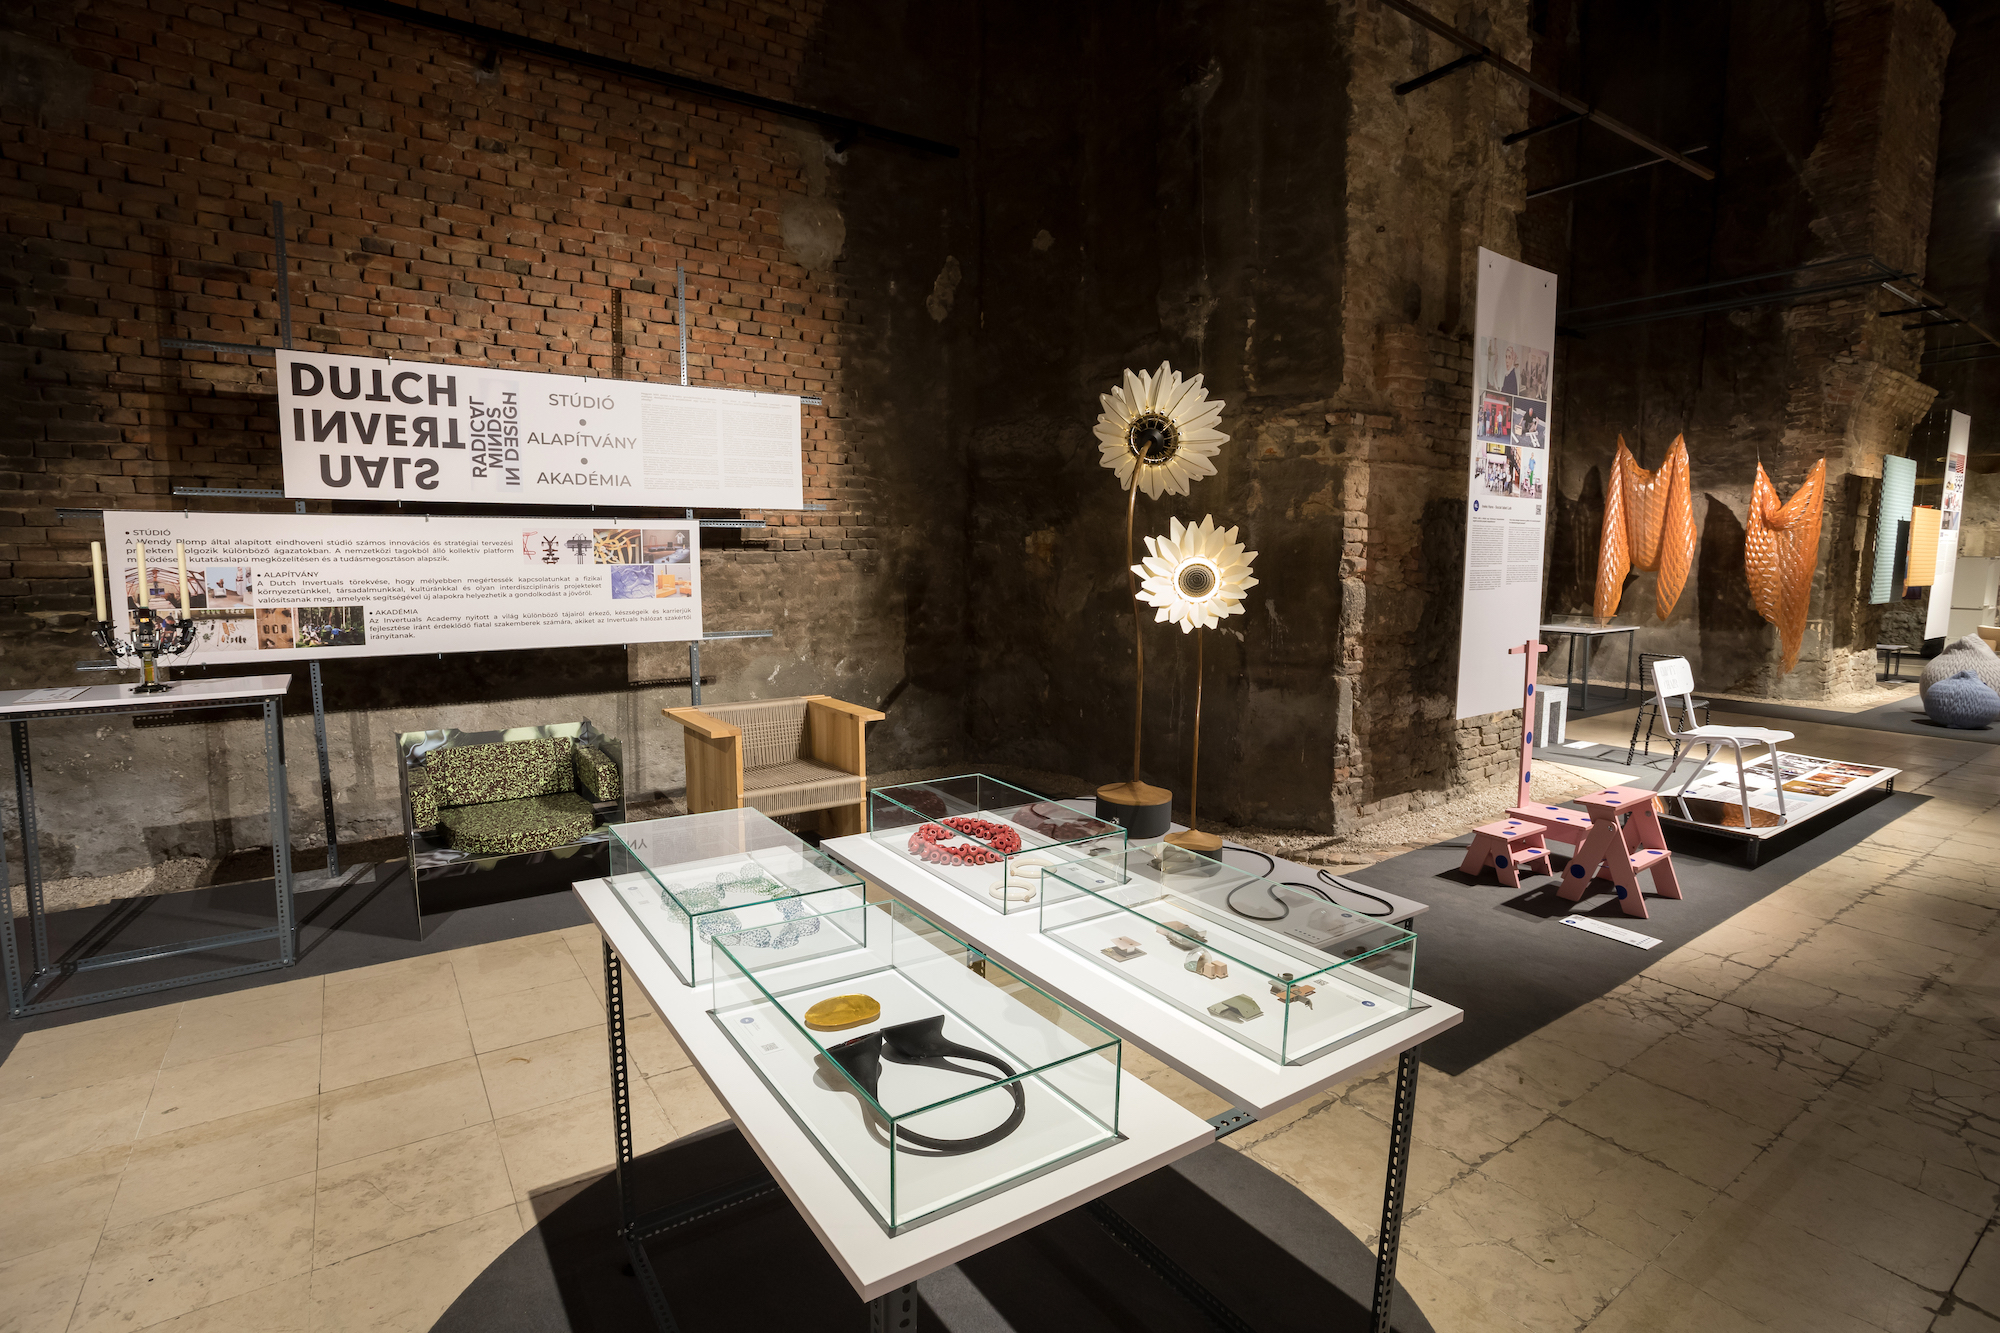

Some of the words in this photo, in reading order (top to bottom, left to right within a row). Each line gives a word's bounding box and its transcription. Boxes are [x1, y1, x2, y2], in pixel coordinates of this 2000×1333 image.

[290, 362, 456, 408] DUTCH
[549, 393, 615, 410] STÚDIÓ
[293, 408, 466, 450] INVERT
[469, 396, 488, 478] RADICAL
[487, 408, 504, 468] MINDS
[527, 431, 638, 450] ALAPÍTVÁNY
[537, 471, 632, 488] AKADÉMIA
[467, 577, 514, 585] megértessék
[518, 576, 571, 584] kapcsolatunkat
[564, 582, 602, 591] projekteket
[466, 592, 507, 600] helyezhetik
[514, 591, 562, 599] gondolkodást
[466, 614, 490, 622] nyitott
[562, 611, 585, 619] tájairól
[369, 624, 411, 633] fejlesztése
